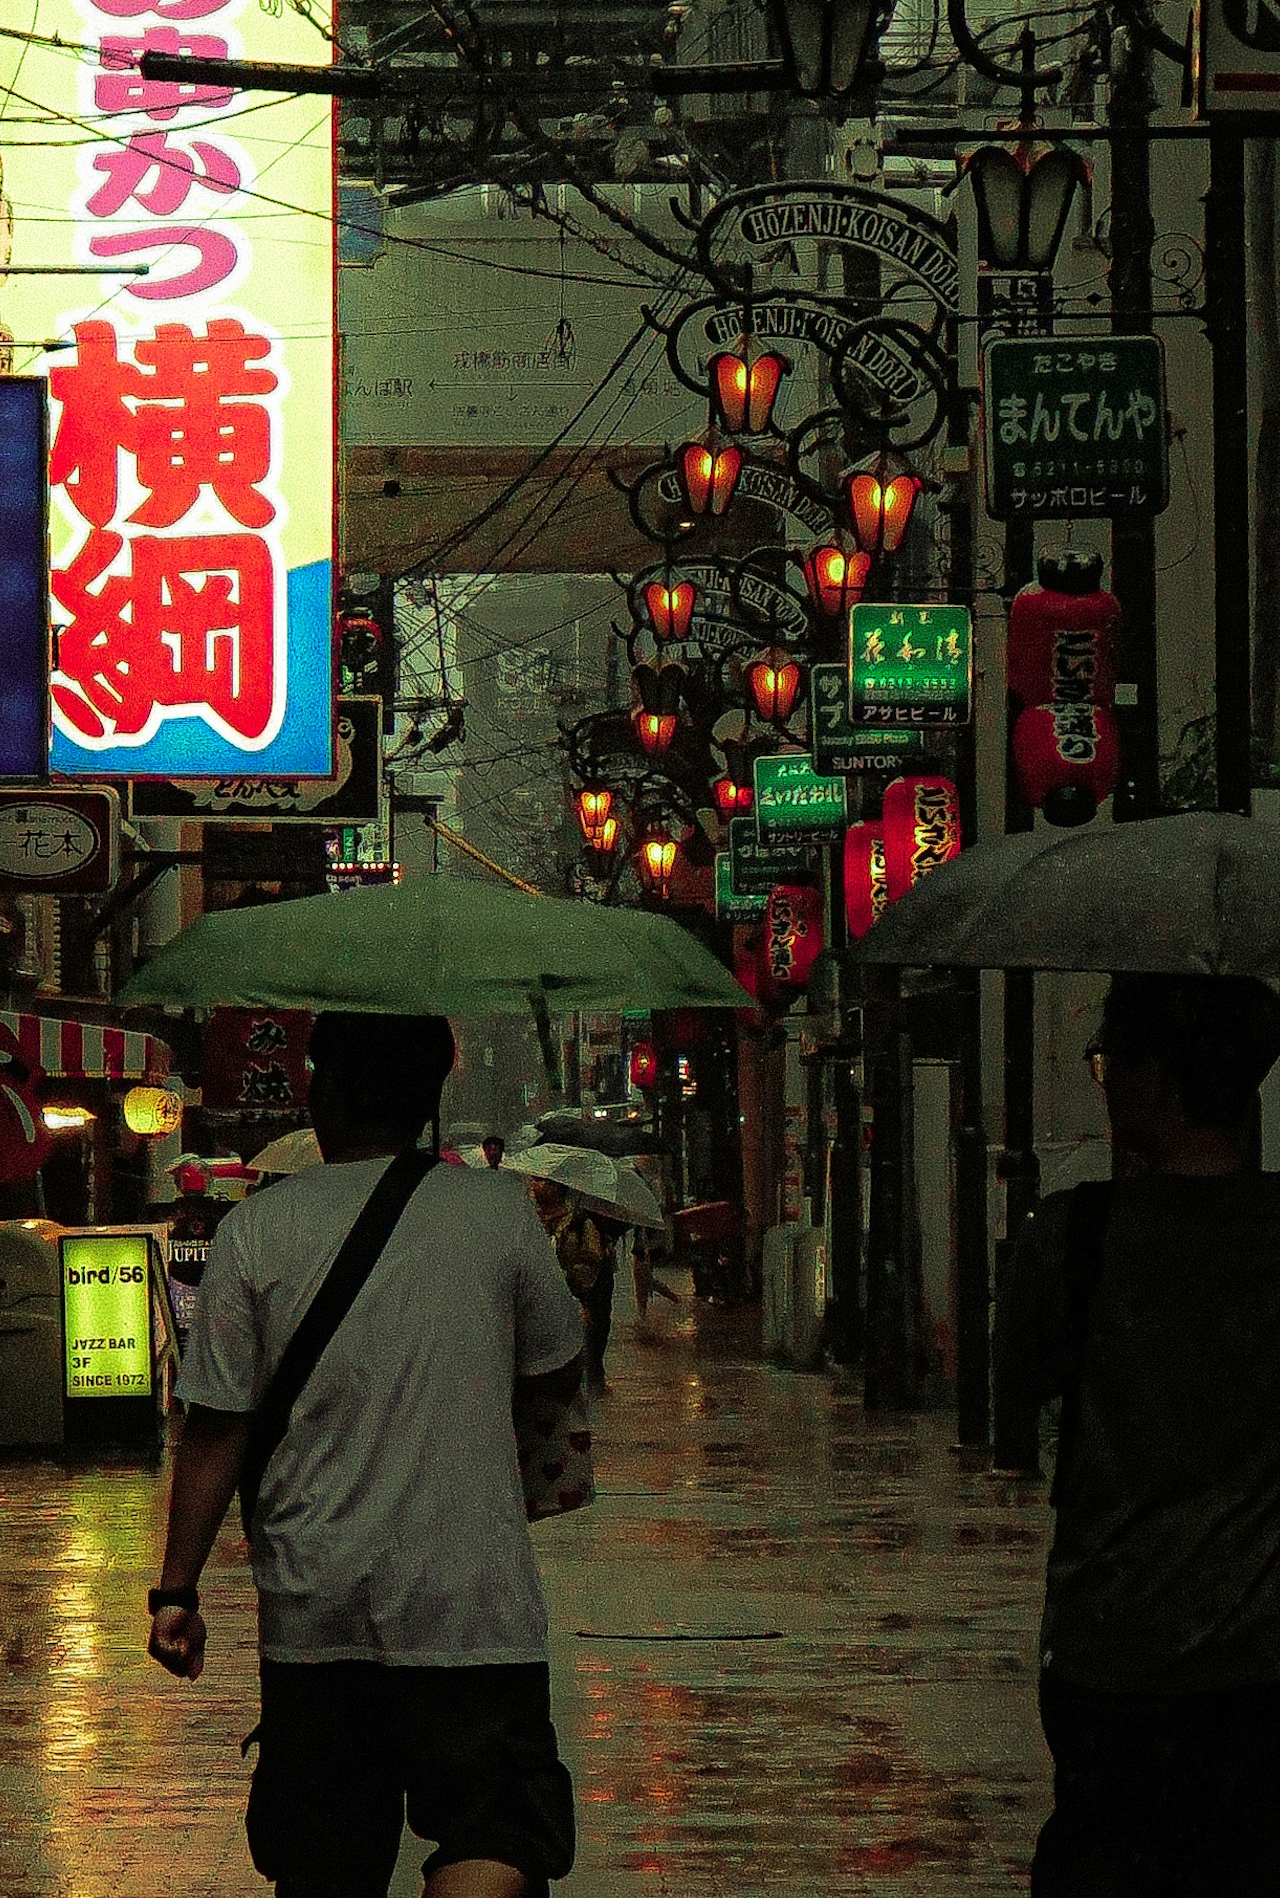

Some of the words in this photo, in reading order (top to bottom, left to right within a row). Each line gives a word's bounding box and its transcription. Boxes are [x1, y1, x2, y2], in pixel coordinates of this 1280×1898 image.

[998, 388, 1157, 445] まんてんや
[1010, 485, 1148, 509] サッポロビール
[50, 318, 279, 740] 横綱
[862, 704, 958, 722] アサヒビール
[68, 1265, 145, 1286] bird/56
[108, 1337, 137, 1350] BAR
[72, 1357, 92, 1369] 3F
[72, 1375, 114, 1387] SINCE
[116, 1373, 145, 1387] 1972
